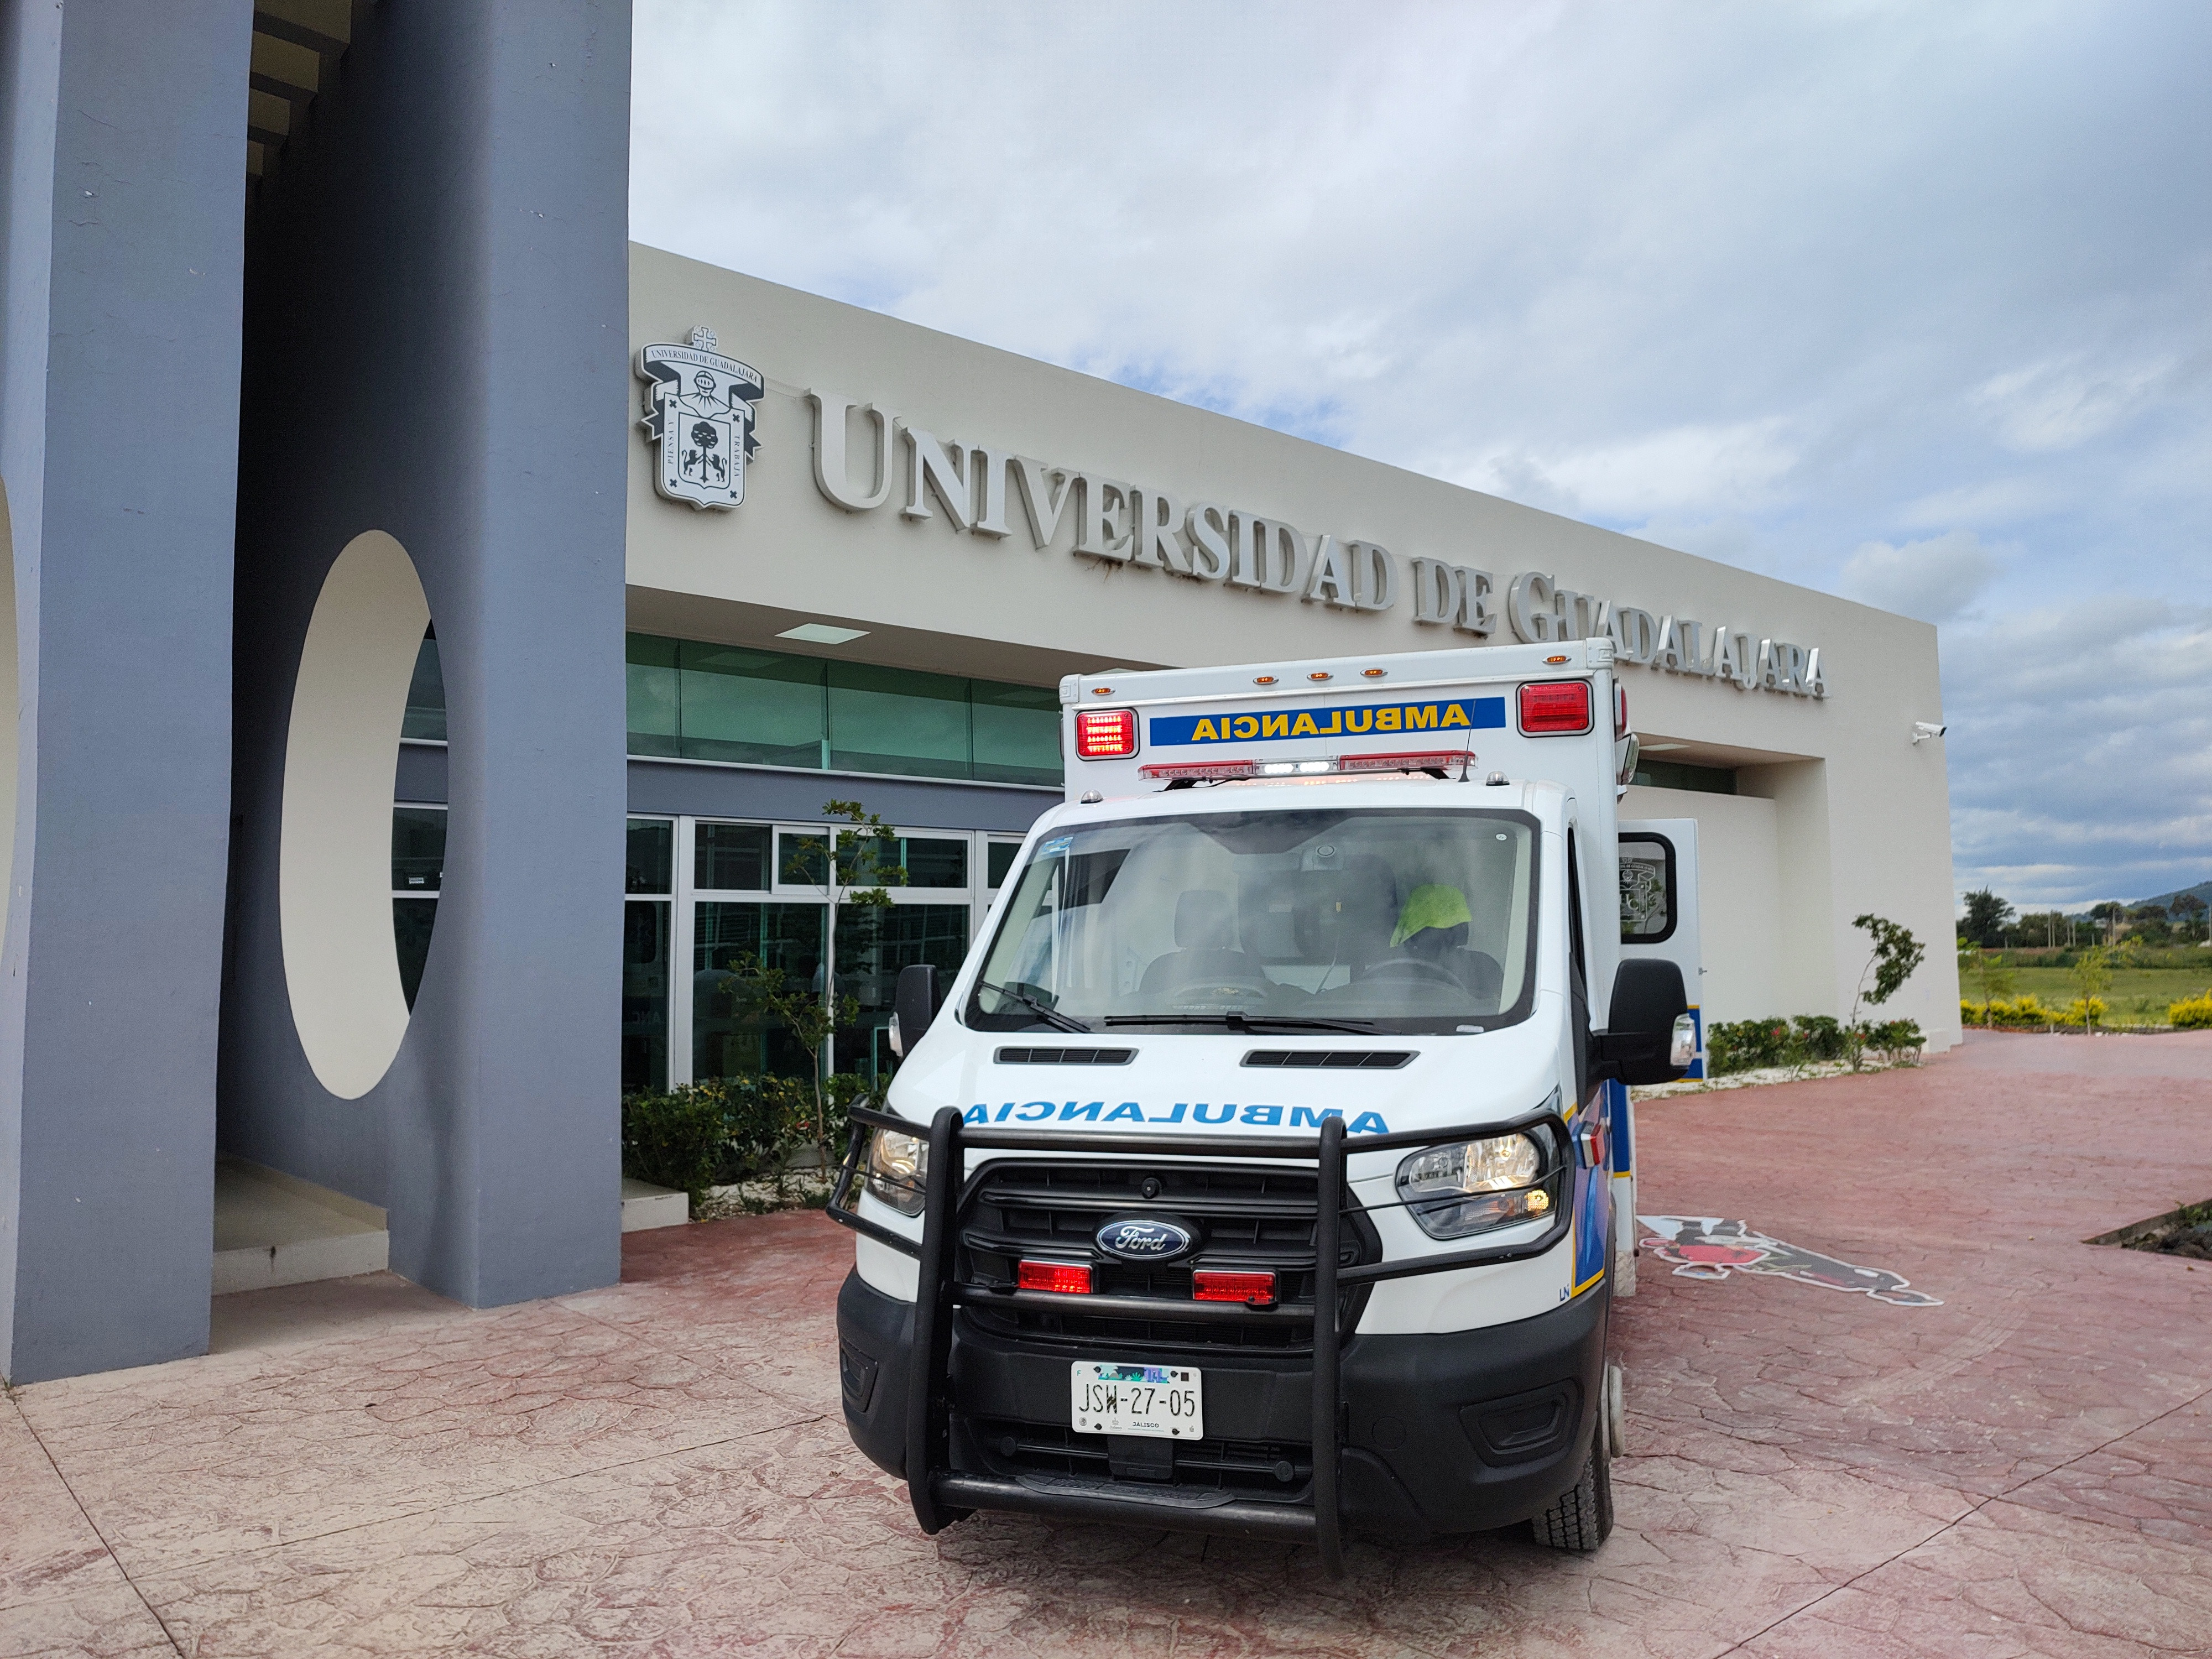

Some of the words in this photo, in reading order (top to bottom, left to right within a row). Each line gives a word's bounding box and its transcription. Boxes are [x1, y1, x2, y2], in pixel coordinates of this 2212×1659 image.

[651, 349, 698, 362] UNIVERSIDAD
[700, 354, 708, 364] DE
[710, 357, 757, 383] GUADALAJARA
[667, 429, 676, 465] PIENSA
[804, 388, 1397, 611] UNIVERSIDAD
[1412, 556, 1497, 637] DE
[1509, 571, 1829, 698] GUADALAJARA
[1115, 1225, 1168, 1250] Ford
[1079, 1384, 1195, 1417] JSW-27-05
